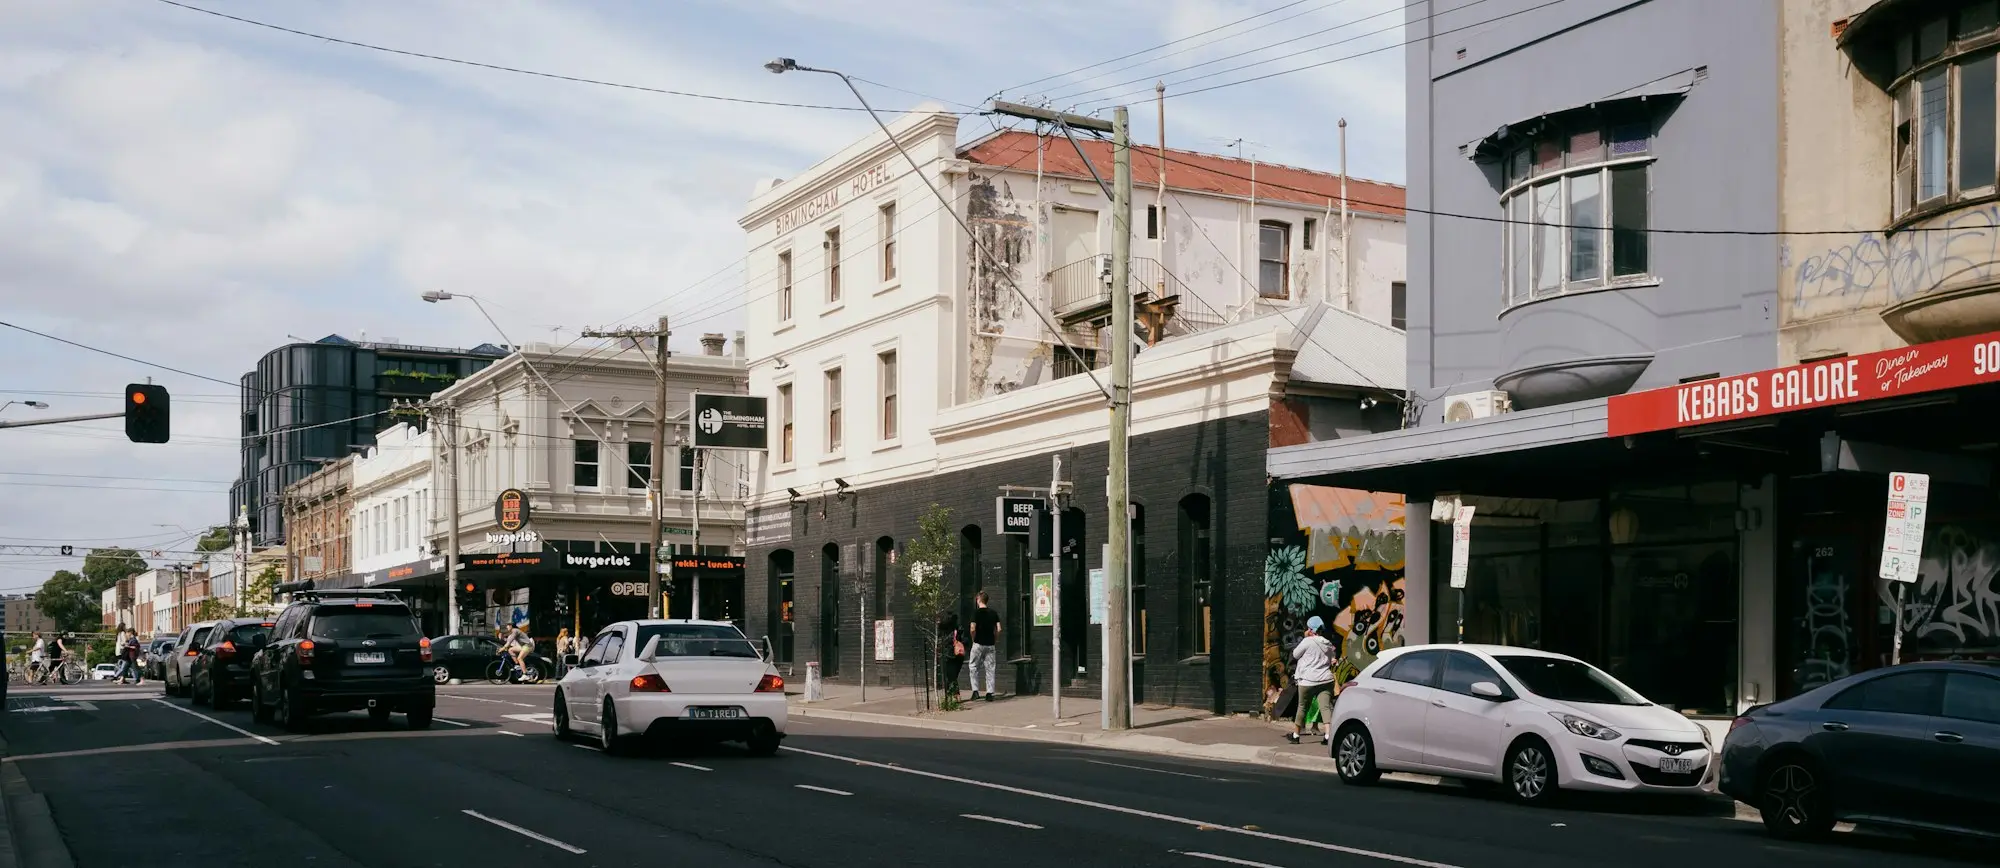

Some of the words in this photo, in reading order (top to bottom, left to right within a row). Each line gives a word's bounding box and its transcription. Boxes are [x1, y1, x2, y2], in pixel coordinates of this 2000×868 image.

[776, 188, 839, 236] BIRMINGHAM
[1876, 356, 1905, 379] Dine
[1906, 349, 1919, 362] in
[1881, 380, 1892, 391] or
[1894, 354, 1949, 389] Takeaway
[1678, 376, 1759, 423] KEBABS
[1771, 359, 1859, 408] GALORE
[1013, 503, 1034, 513] BEER
[503, 511, 520, 520] LOT
[1007, 516, 1030, 526] GARD
[485, 531, 538, 546] burgerlot
[1815, 547, 1834, 557] 262
[566, 553, 631, 569] burgerlot
[675, 559, 698, 568] rekki
[707, 560, 734, 569] lunch
[708, 709, 737, 718] TIRED
